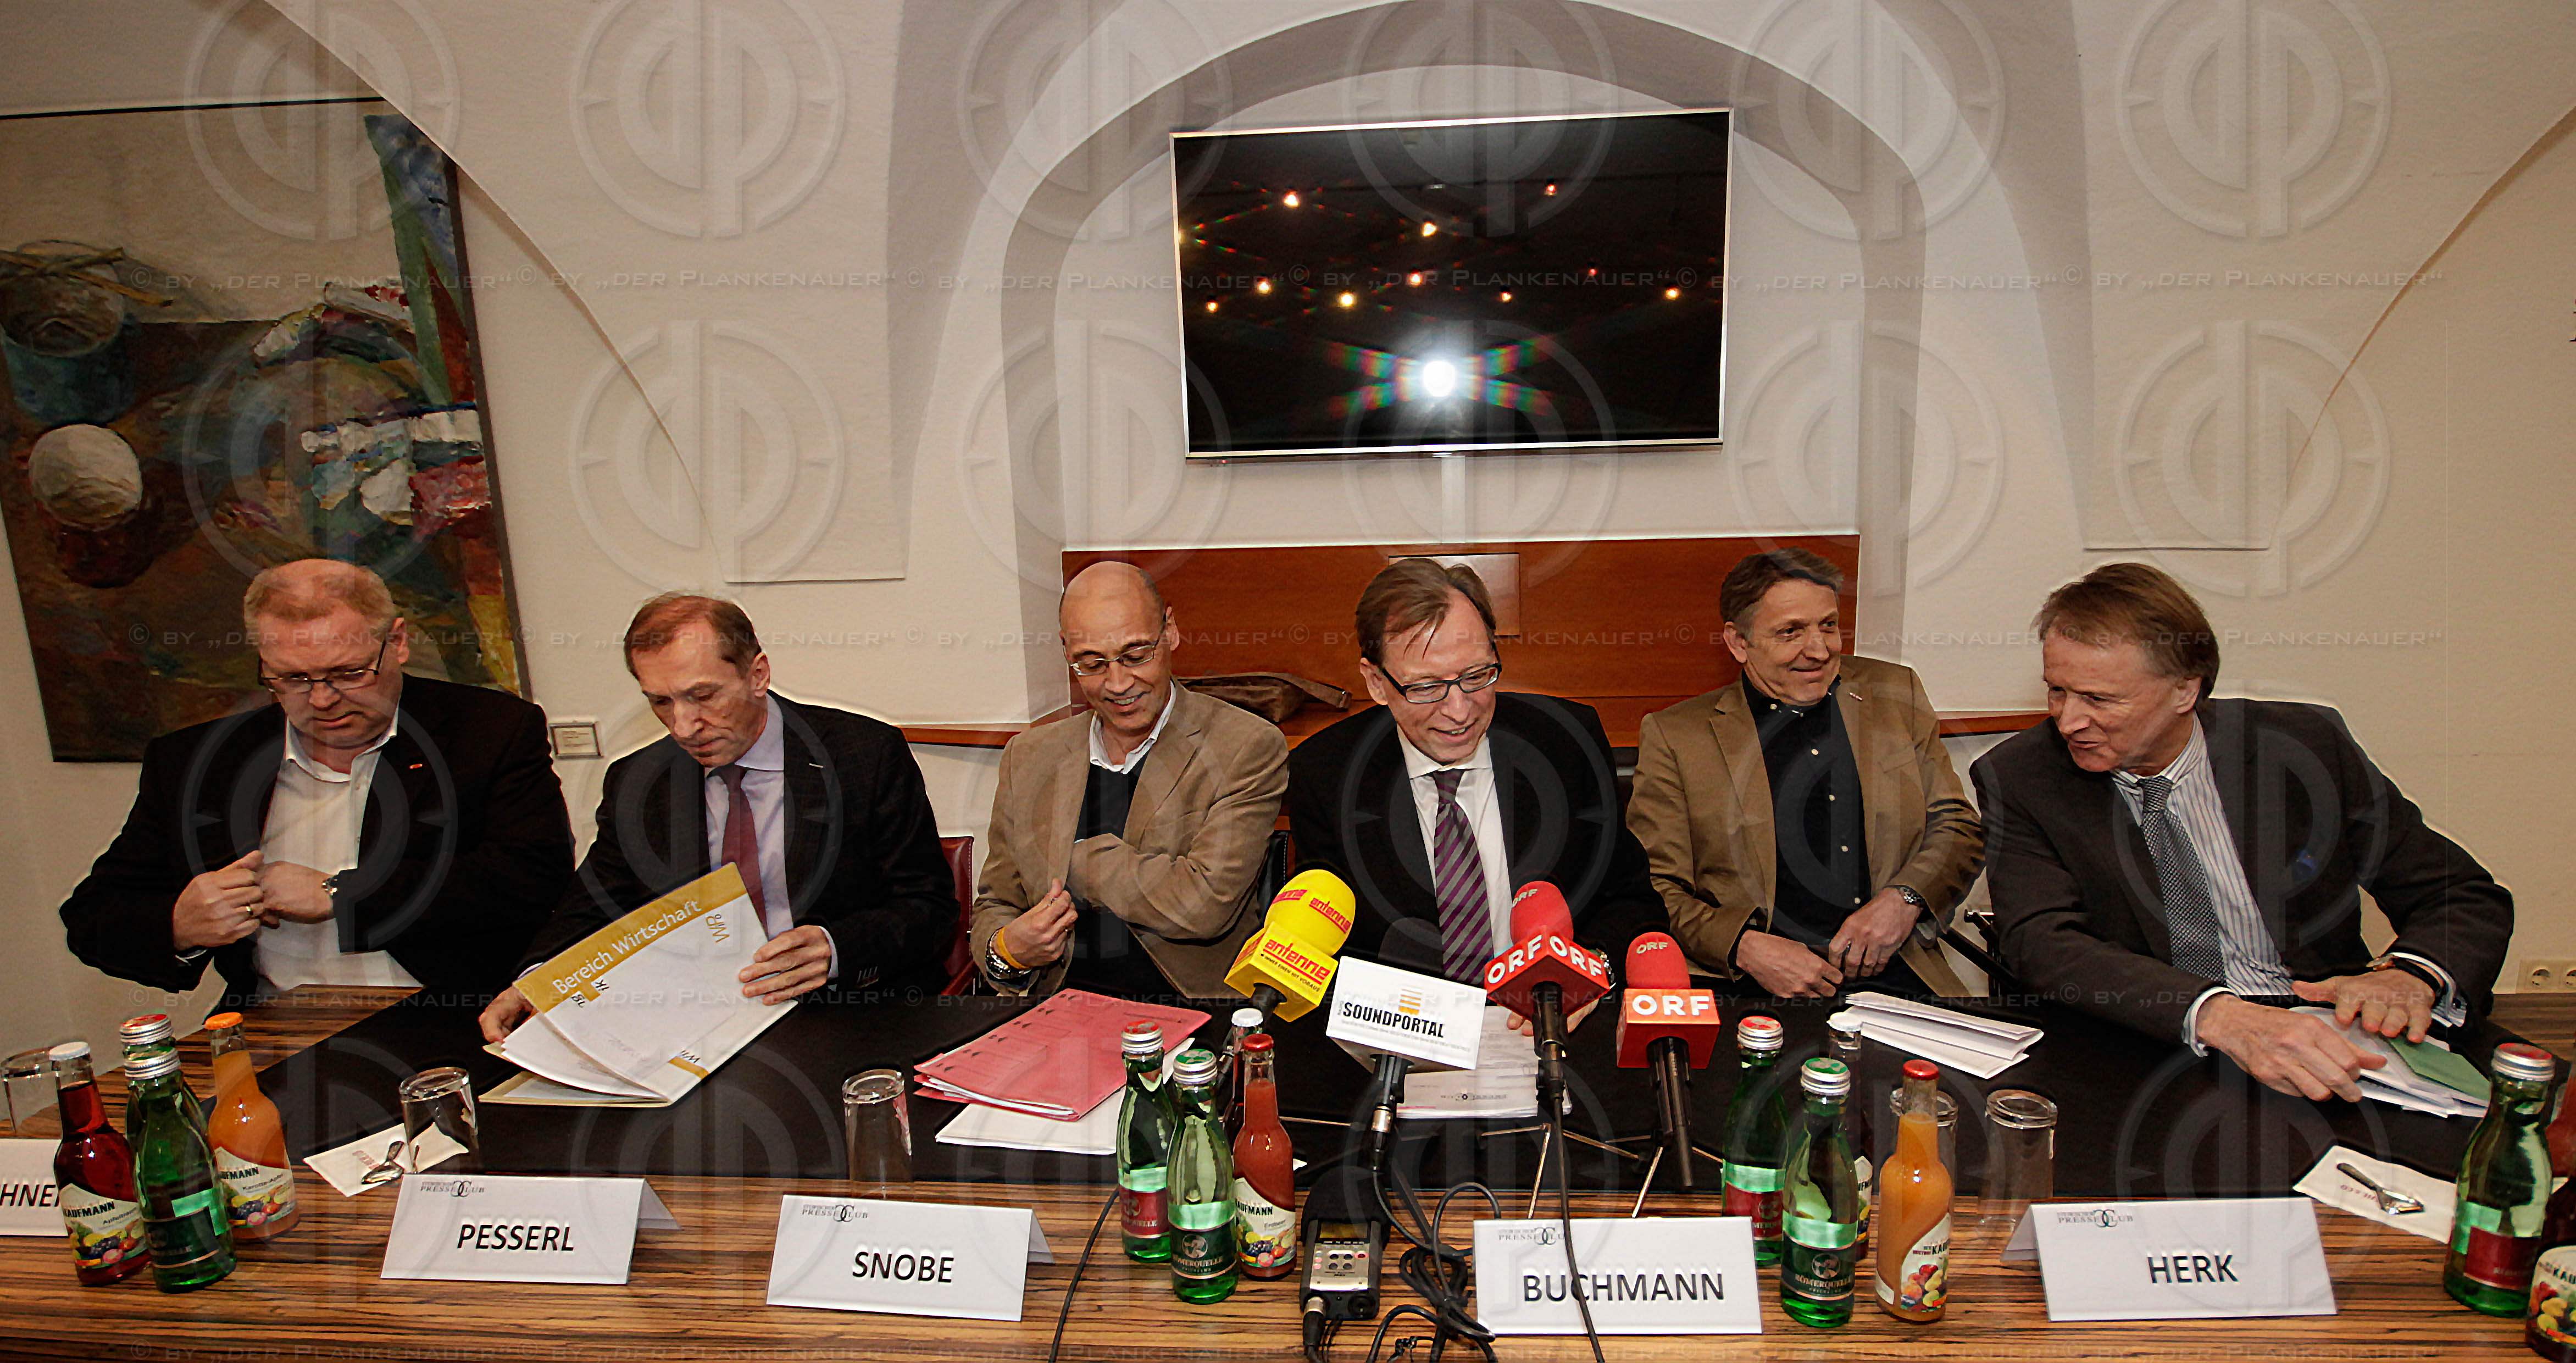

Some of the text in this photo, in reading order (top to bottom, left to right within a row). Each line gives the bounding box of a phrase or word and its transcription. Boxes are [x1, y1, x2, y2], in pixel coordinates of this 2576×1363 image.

[1513, 889, 1538, 907] ORF
[1309, 897, 1352, 934] antenne
[552, 899, 702, 994] Bereich Wirtschaft
[1264, 939, 1331, 982] antenne
[1487, 934, 1544, 984] ORF
[1549, 935, 1603, 977] ORF
[1636, 941, 1669, 955] ORF
[1300, 977, 1321, 993] VORAUS
[1342, 1001, 1445, 1038] SOUNDPORTAL
[1631, 995, 1710, 1016] ORF
[0, 1183, 60, 1207] HNE
[457, 1223, 575, 1252] PESSERL
[852, 1250, 954, 1284] SNOBE
[2147, 1253, 2239, 1284] HERK
[1523, 1272, 1724, 1303] BUCHMANN
